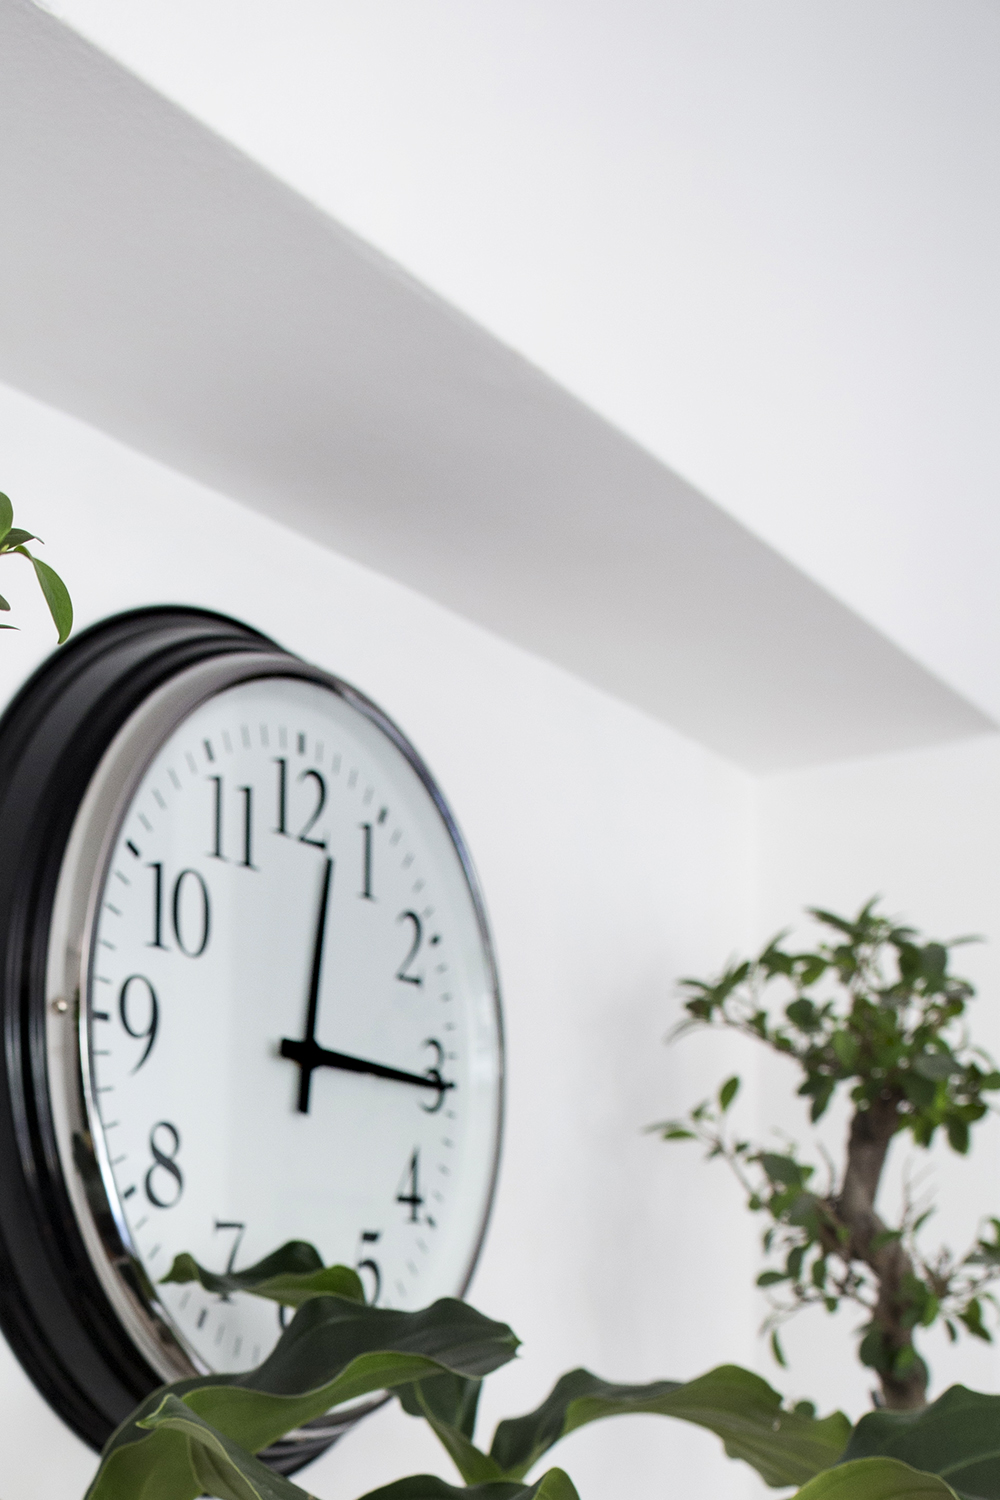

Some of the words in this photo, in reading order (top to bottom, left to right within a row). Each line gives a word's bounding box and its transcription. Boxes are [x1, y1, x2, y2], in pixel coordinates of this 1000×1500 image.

[208, 774, 259, 871] 11
[271, 757, 327, 850] 12
[358, 822, 375, 899] 1
[144, 861, 211, 958] 10
[396, 910, 424, 987] 2
[118, 973, 160, 1076] 9
[420, 1038, 446, 1113] 3
[144, 1121, 185, 1209] 8
[395, 1147, 424, 1225] 4
[213, 1220, 246, 1303] 7
[357, 1229, 382, 1308] 5
